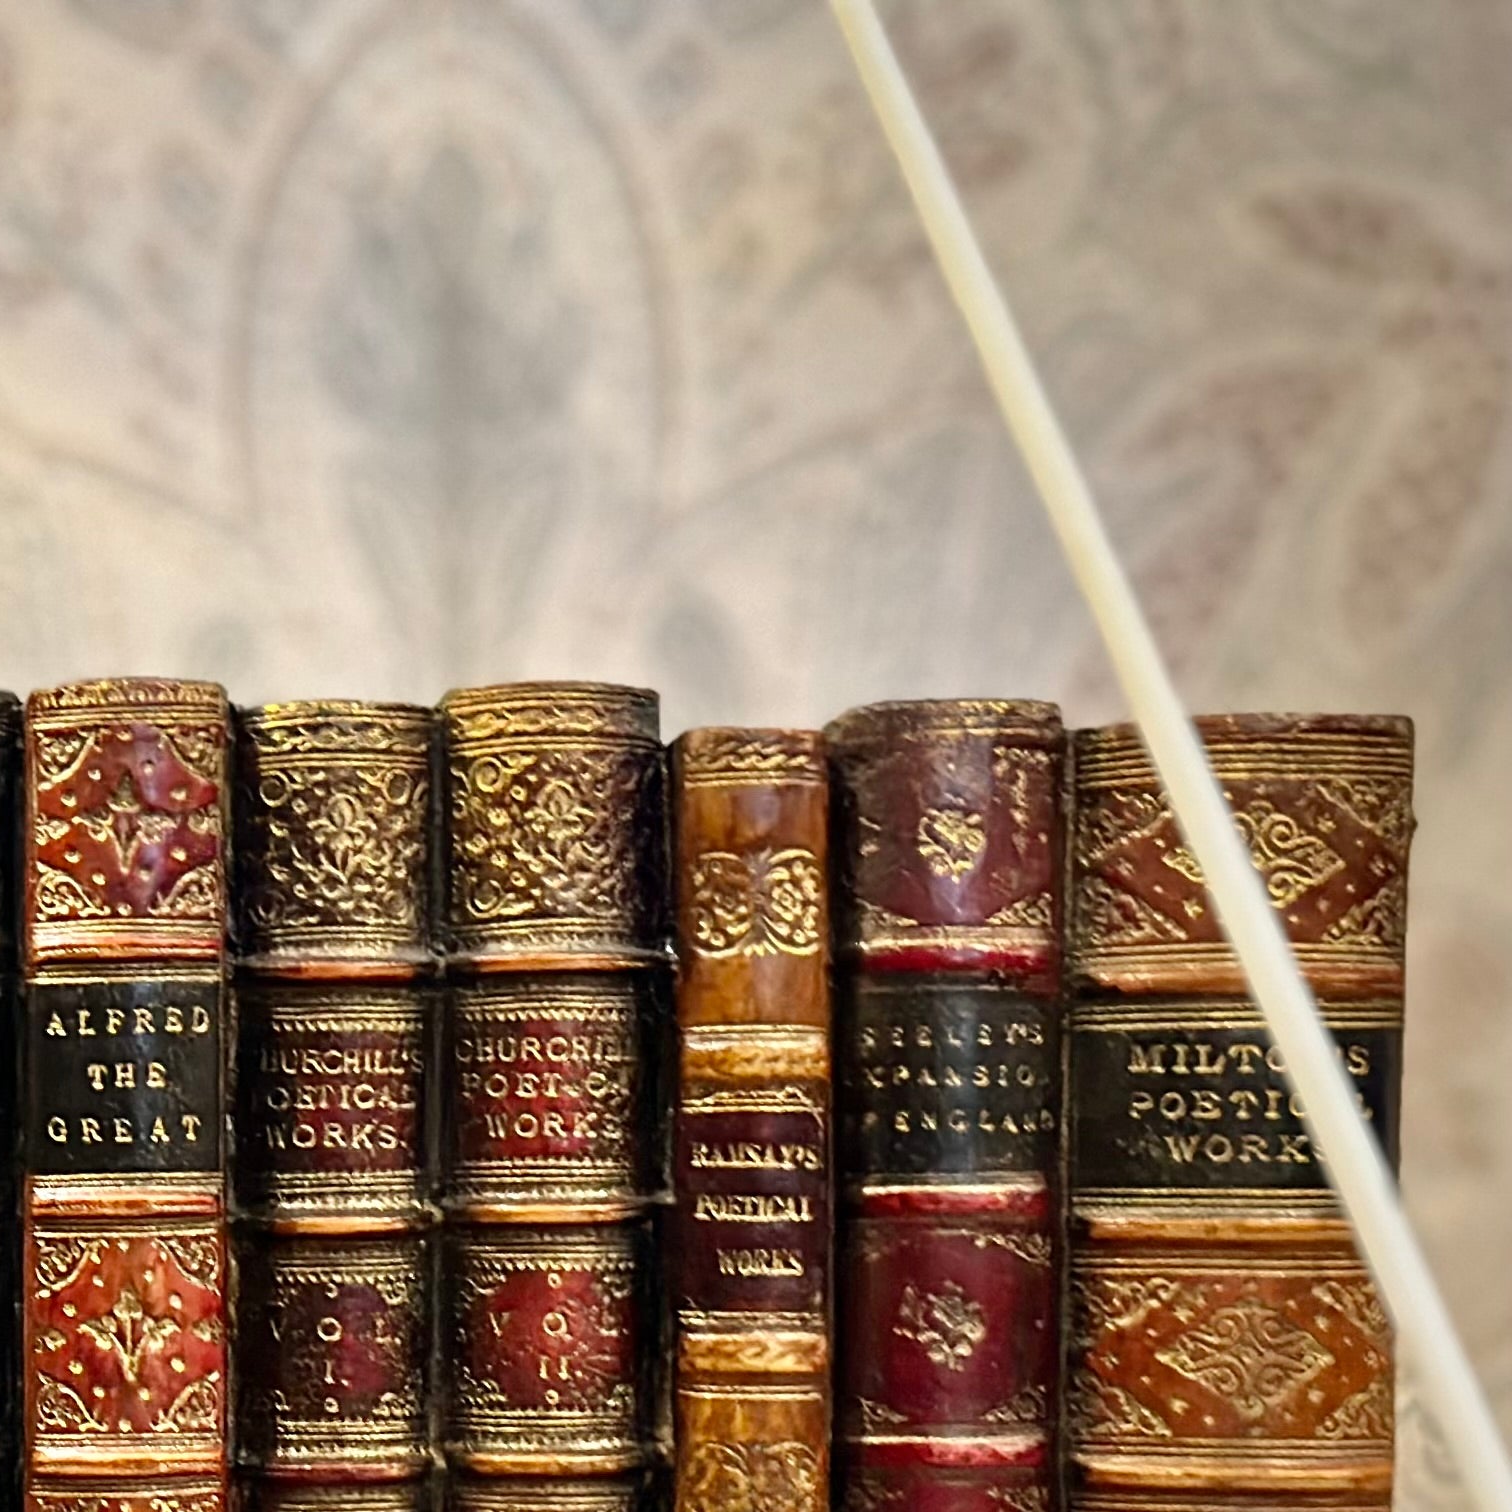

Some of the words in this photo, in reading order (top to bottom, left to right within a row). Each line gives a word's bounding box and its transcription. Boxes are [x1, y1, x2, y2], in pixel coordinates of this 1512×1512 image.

[45, 1005, 211, 1037] ALFRED
[87, 1061, 168, 1091] THE
[47, 1114, 202, 1144] GREAT
[693, 1194, 814, 1223] POETICAL
[716, 1248, 804, 1277] WORKS
